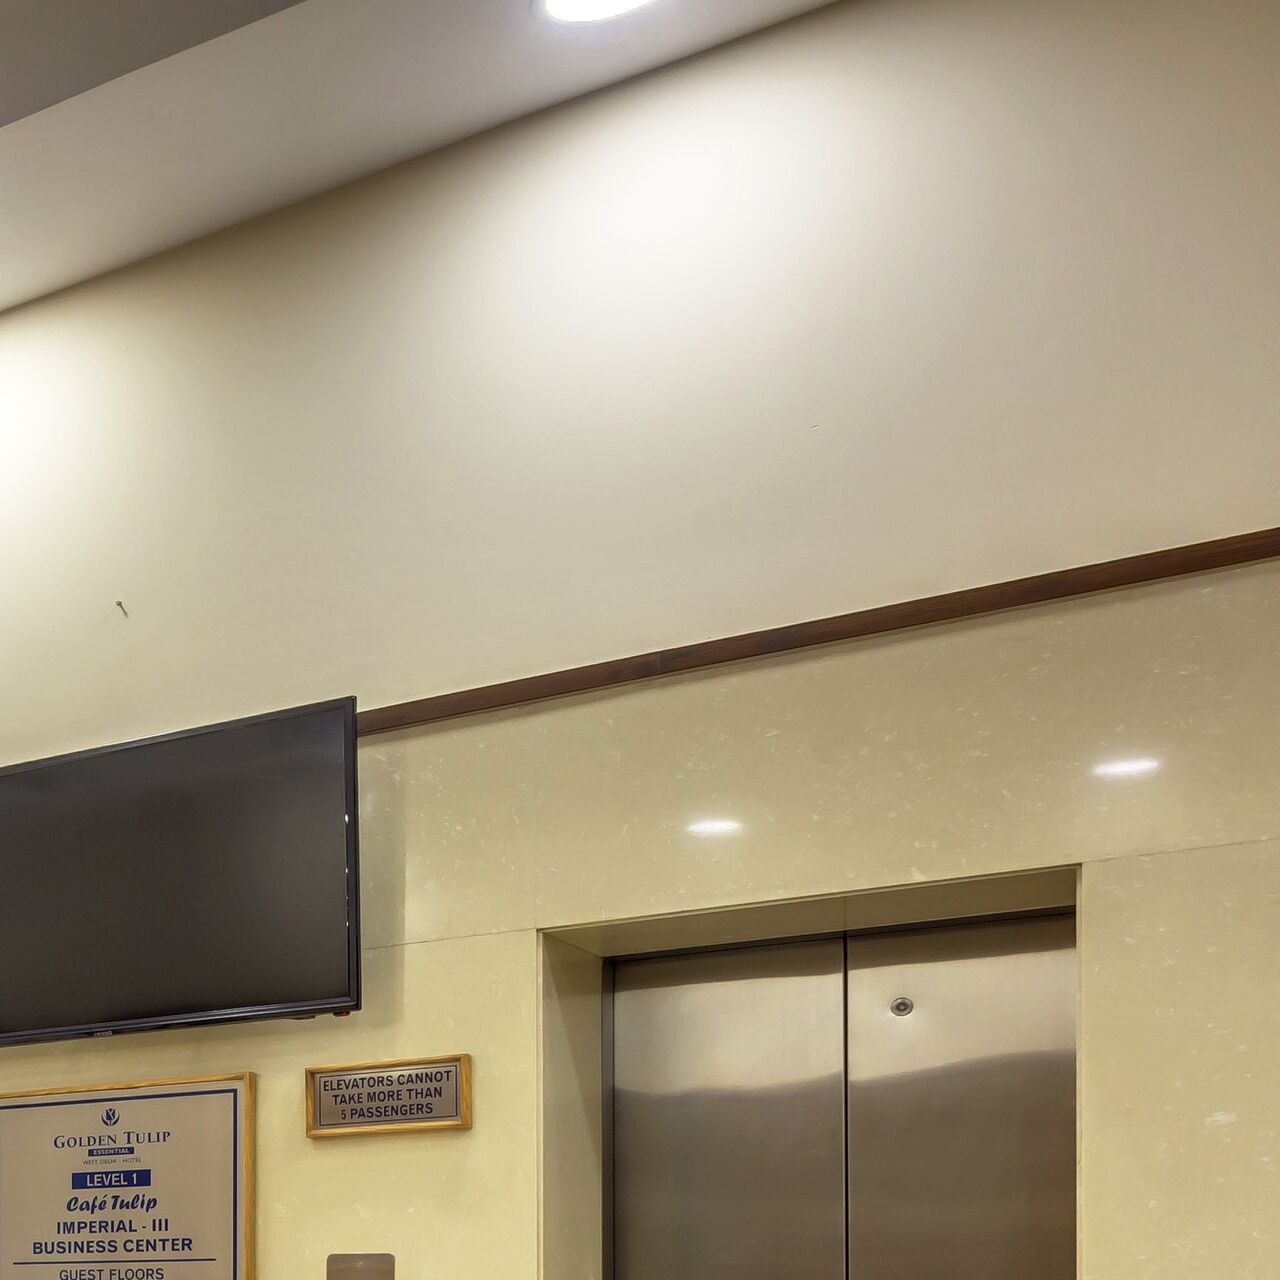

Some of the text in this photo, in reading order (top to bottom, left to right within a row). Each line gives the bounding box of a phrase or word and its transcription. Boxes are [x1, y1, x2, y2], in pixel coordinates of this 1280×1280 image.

[323, 1070, 453, 1092] ELEVATORS CANNOT
[332, 1086, 443, 1106] TAKE MORE THAN
[340, 1102, 434, 1120] 5 PASSENGERS
[53, 1130, 172, 1149] GOLDEN TULIP
[86, 1172, 137, 1187] LEVEL 1
[66, 1194, 158, 1214] Café Tulip
[57, 1219, 138, 1235] IMPERIAL
[152, 1218, 169, 1232] III
[32, 1238, 193, 1255] BUSINESS CENTER
[59, 1268, 165, 1280] GUEST FLOORS
